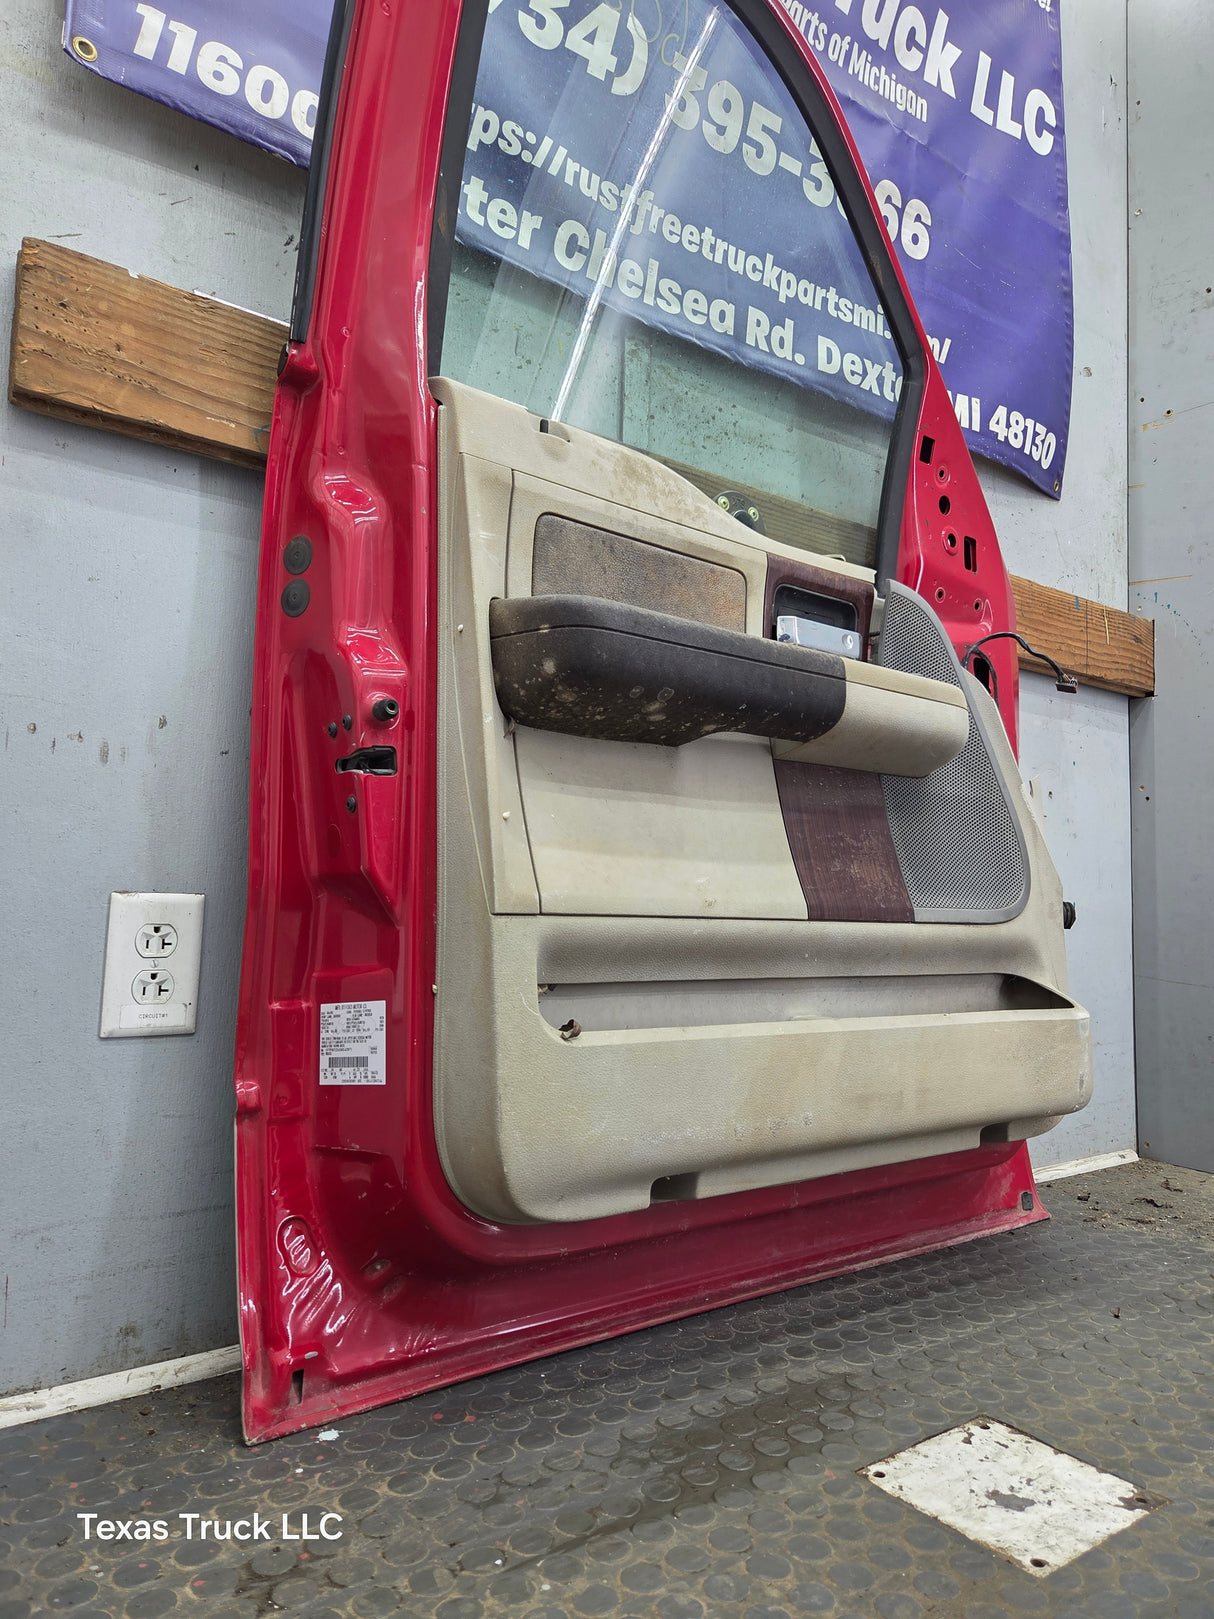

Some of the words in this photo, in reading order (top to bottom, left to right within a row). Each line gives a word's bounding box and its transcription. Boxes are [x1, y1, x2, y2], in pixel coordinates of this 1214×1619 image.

[488, 0, 648, 96] 34)
[664, 50, 932, 260] 395-366
[828, 33, 851, 68] of
[848, 41, 928, 123] Michigan
[834, 0, 962, 99] uck
[970, 51, 1057, 156] LLC
[457, 175, 543, 250] ter
[553, 219, 734, 334] Chelsea
[745, 306, 805, 366] Rd.
[947, 390, 981, 432] MI
[989, 405, 1057, 470] 48130
